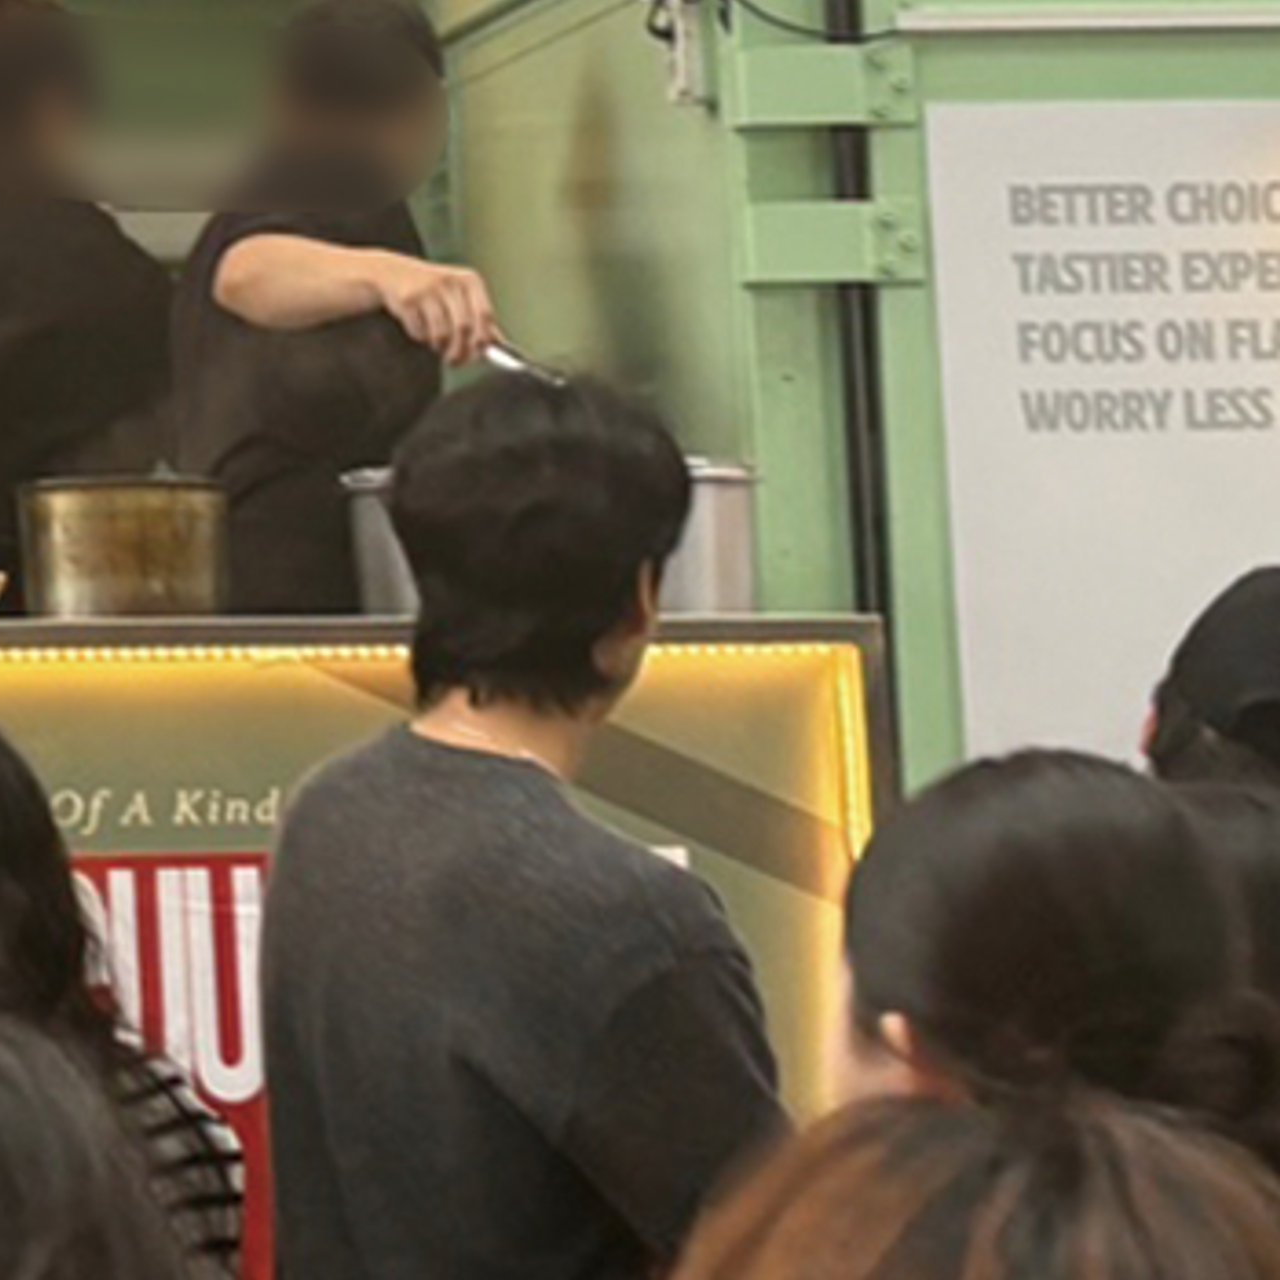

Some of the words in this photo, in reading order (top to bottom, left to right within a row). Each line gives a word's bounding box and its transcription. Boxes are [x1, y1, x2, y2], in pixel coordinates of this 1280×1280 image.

[1006, 183, 1157, 227] BETTER
[1010, 252, 1172, 296] TASTIER
[1181, 250, 1280, 292] EXPE
[1015, 319, 1147, 364] FOCUS
[1156, 319, 1214, 362] ON
[1019, 389, 1175, 433] WORRY
[1184, 389, 1275, 431] LESS
[50, 787, 113, 836] Of
[118, 790, 153, 826] A
[172, 786, 280, 826] Kind
